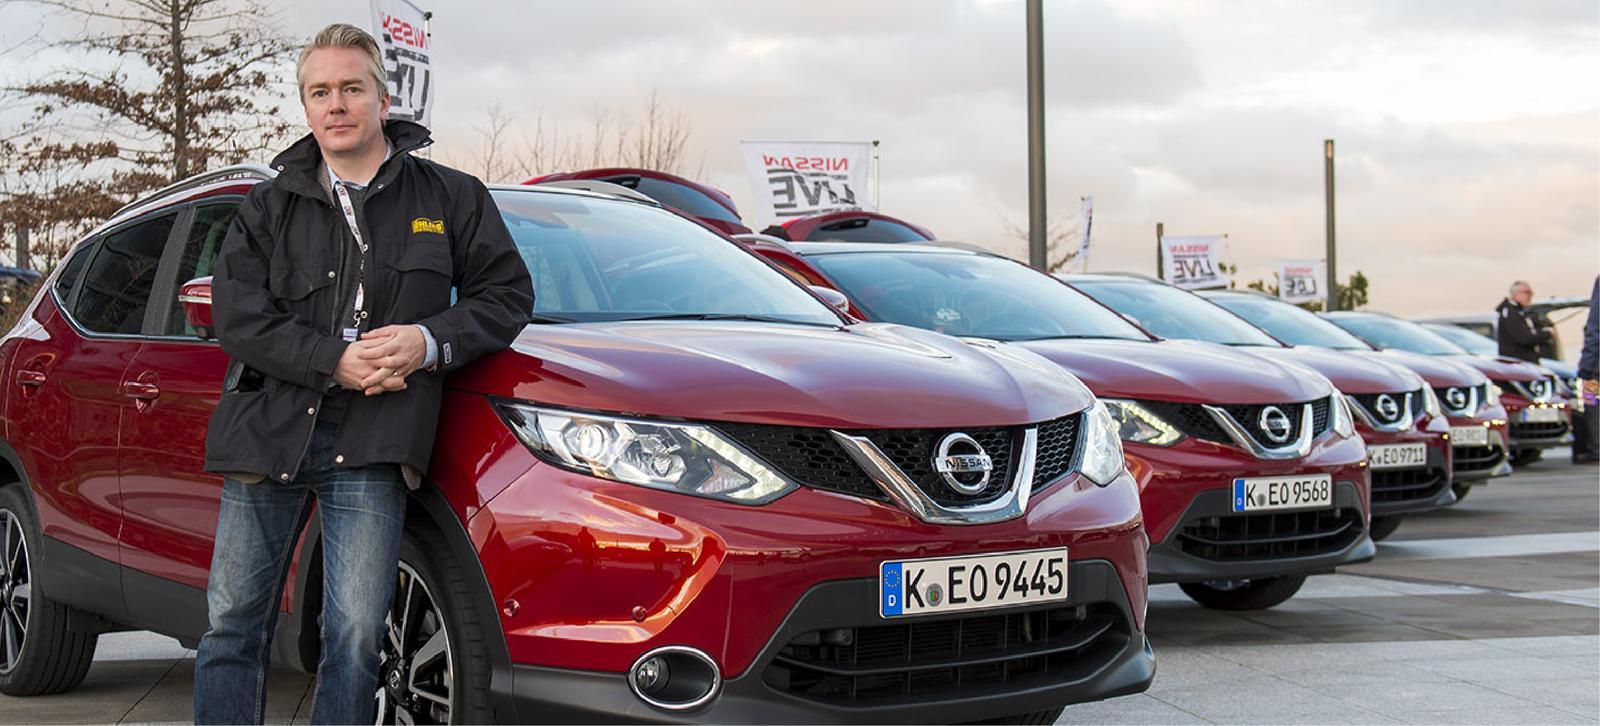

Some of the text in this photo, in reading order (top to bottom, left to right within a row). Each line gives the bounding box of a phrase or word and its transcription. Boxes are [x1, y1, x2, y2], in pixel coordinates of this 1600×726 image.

[945, 457, 991, 469] NISSAN
[1400, 446, 1424, 464] 9711
[1246, 484, 1256, 507] K
[1293, 480, 1329, 504] 9568
[905, 557, 1064, 609] K EO 9445
[888, 594, 897, 607] D
